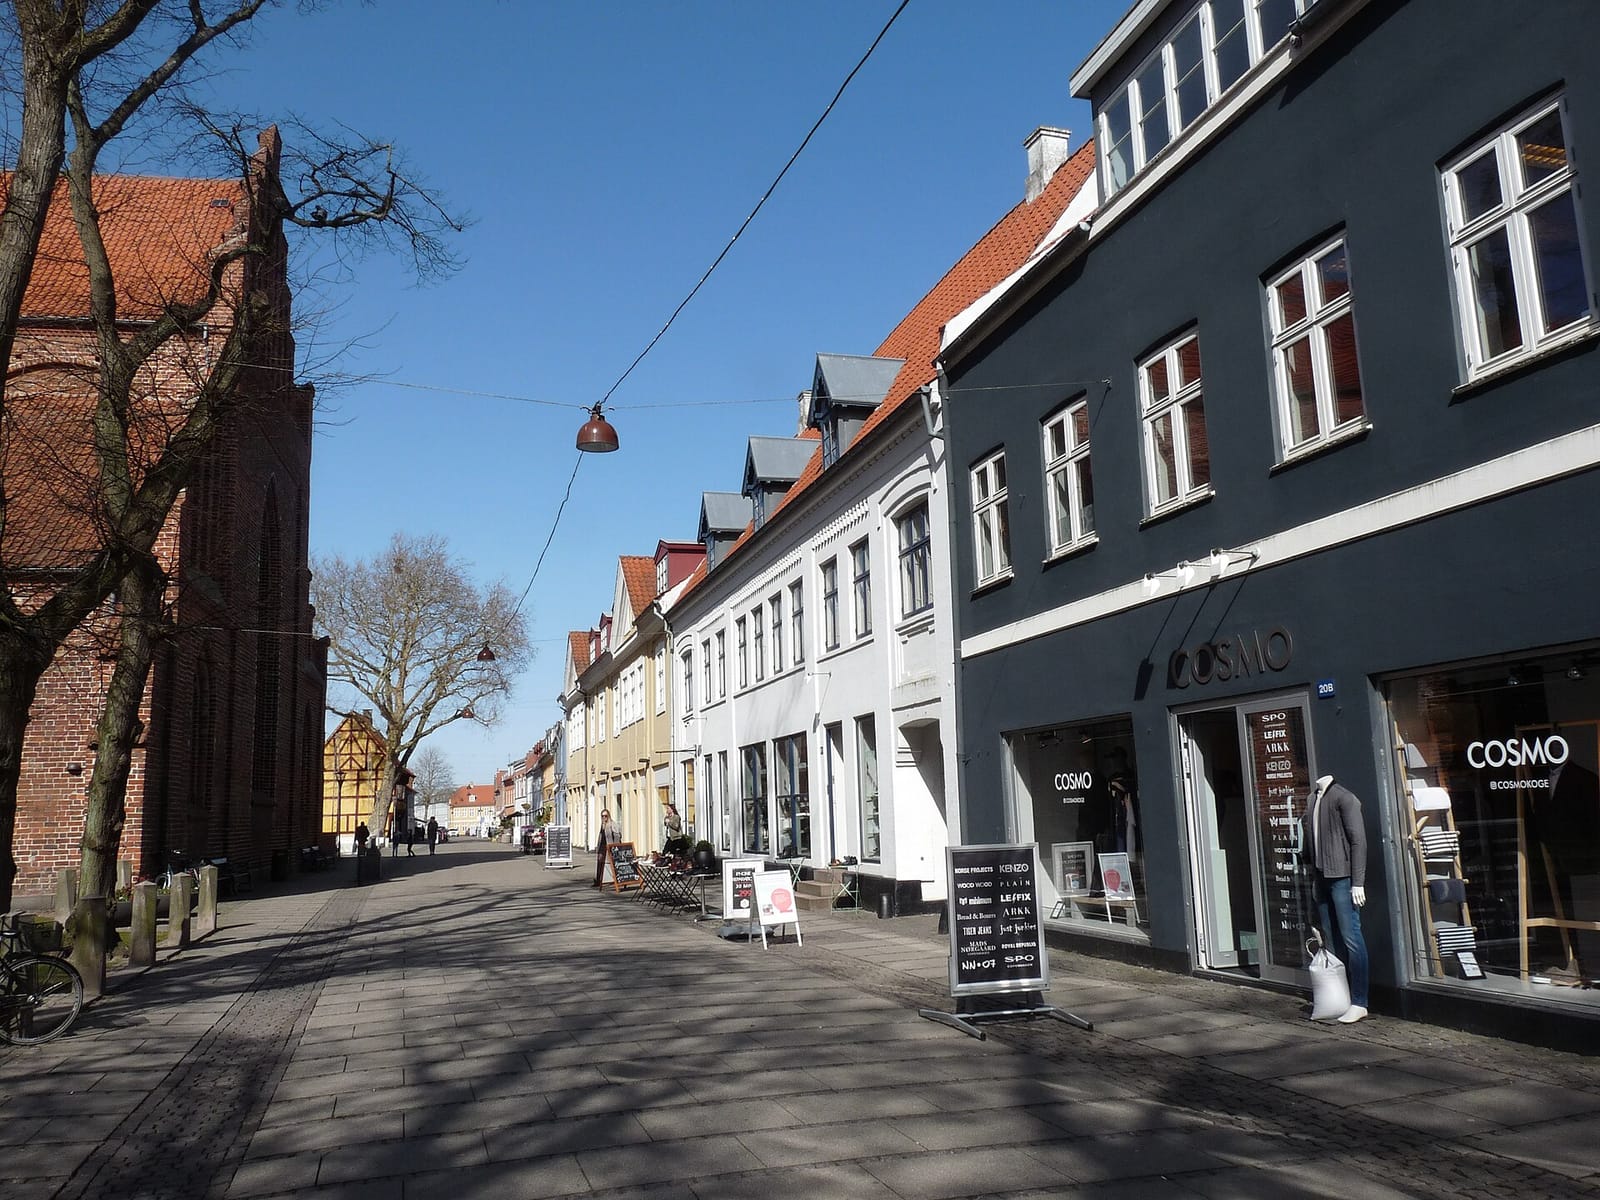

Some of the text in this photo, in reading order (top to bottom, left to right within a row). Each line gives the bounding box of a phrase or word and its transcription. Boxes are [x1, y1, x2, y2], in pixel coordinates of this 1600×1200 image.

[1171, 625, 1293, 688] COSMO
[1318, 683, 1334, 694] 20B
[1466, 735, 1569, 768] COSMO
[1054, 772, 1092, 790] COSMO
[999, 864, 1029, 873] KENZO
